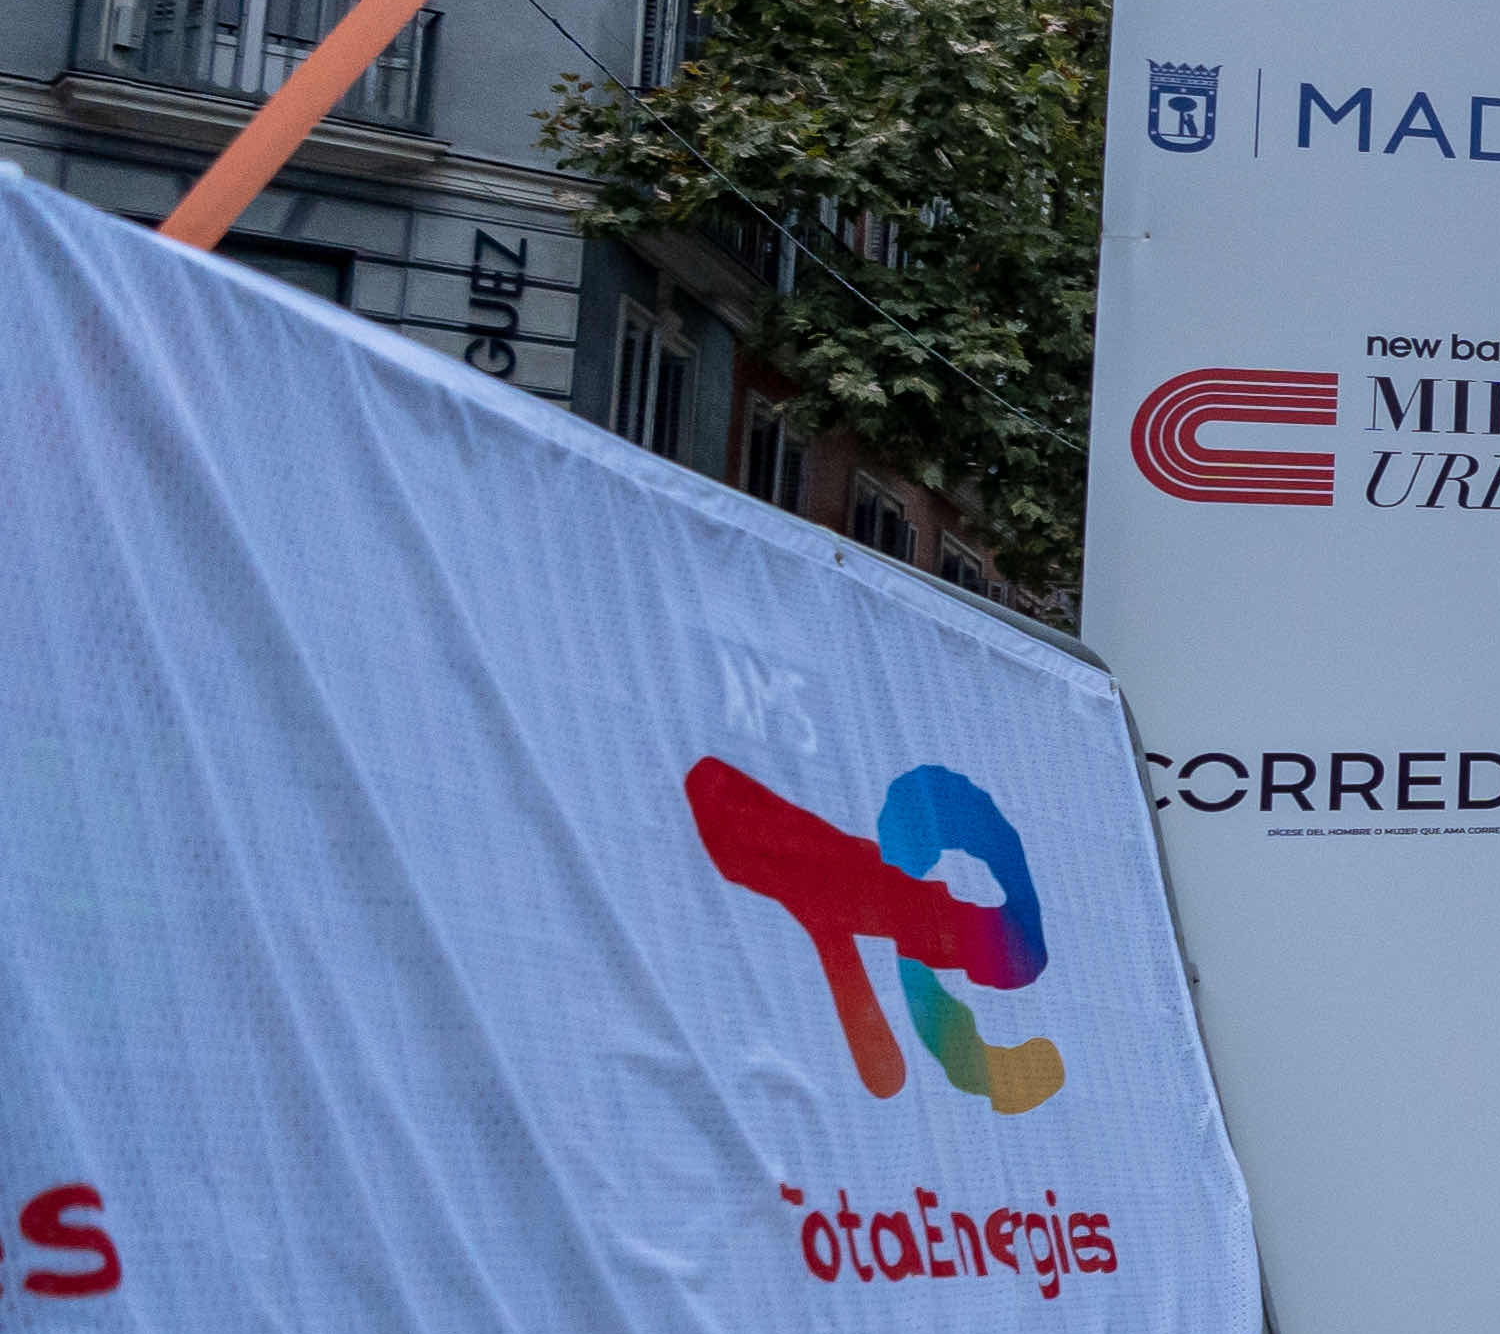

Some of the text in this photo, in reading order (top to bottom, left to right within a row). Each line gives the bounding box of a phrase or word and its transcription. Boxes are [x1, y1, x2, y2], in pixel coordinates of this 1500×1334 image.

[1366, 337, 1441, 362] new
[1306, 827, 1326, 837] DEL
[1420, 826, 1441, 835] QUE
[1444, 826, 1465, 835] AMA
